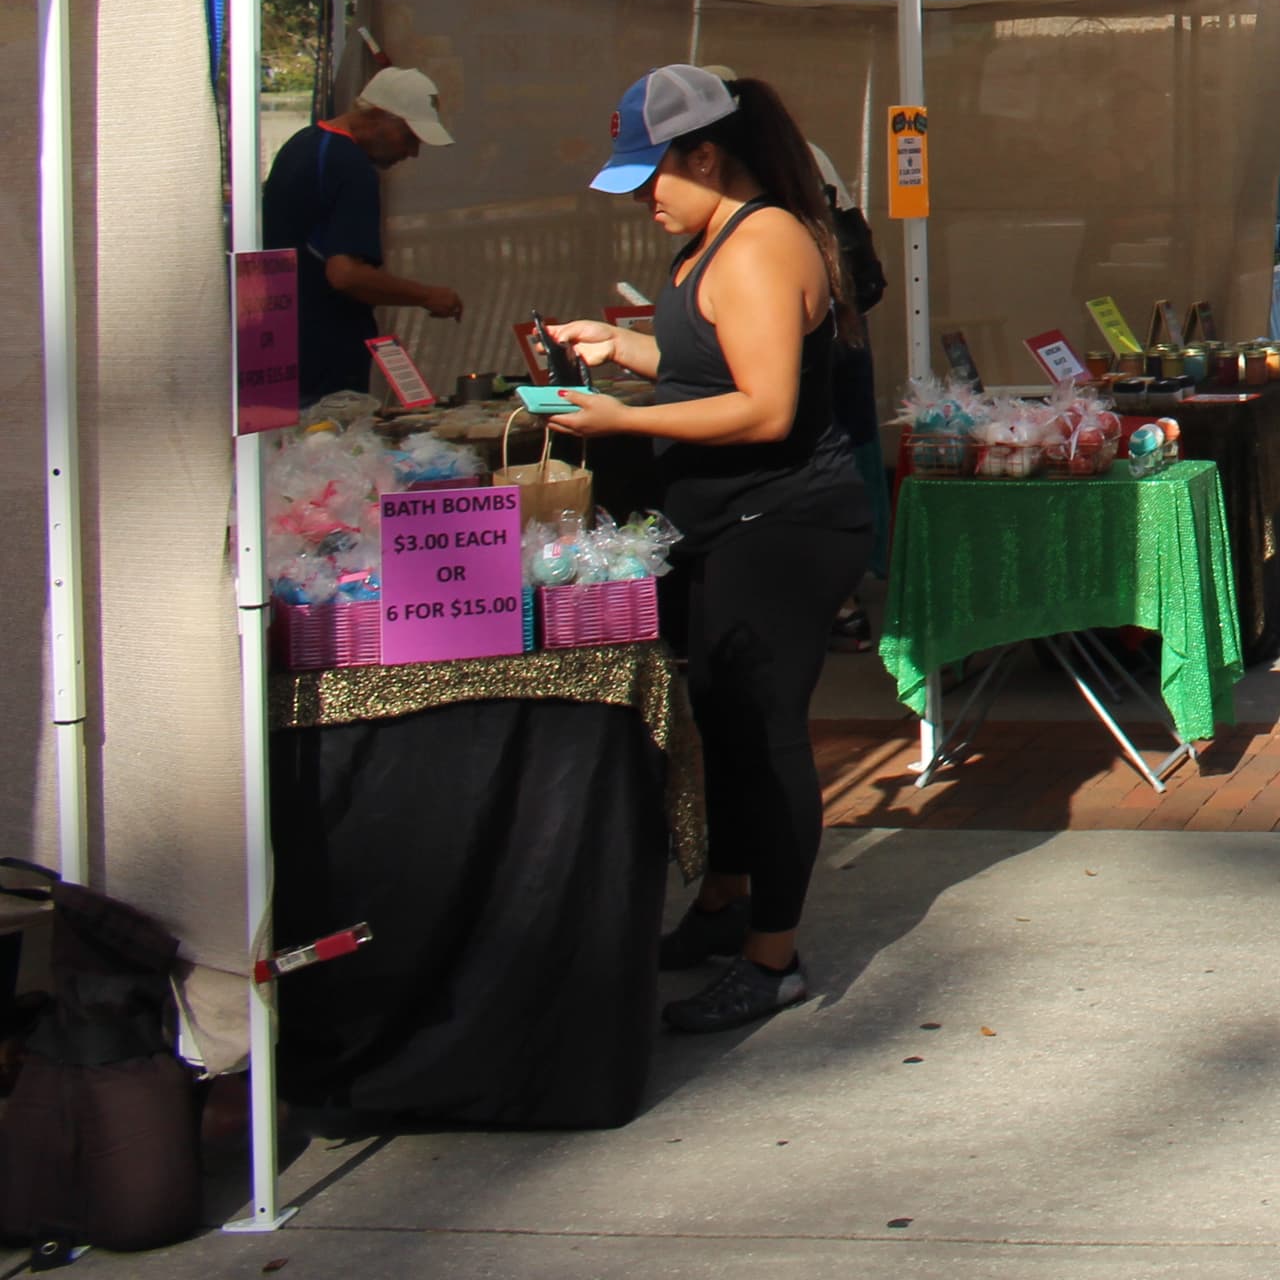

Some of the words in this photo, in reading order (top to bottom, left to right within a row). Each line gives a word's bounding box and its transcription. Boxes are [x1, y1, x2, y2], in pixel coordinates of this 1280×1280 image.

[383, 499, 435, 518] BATH
[443, 494, 517, 514] BOMBS
[394, 533, 449, 555] $3.00
[455, 530, 507, 548] EACH
[436, 565, 466, 583] OR
[386, 605, 399, 621] 6
[404, 602, 445, 620] FOR
[451, 596, 517, 619] $15.00
